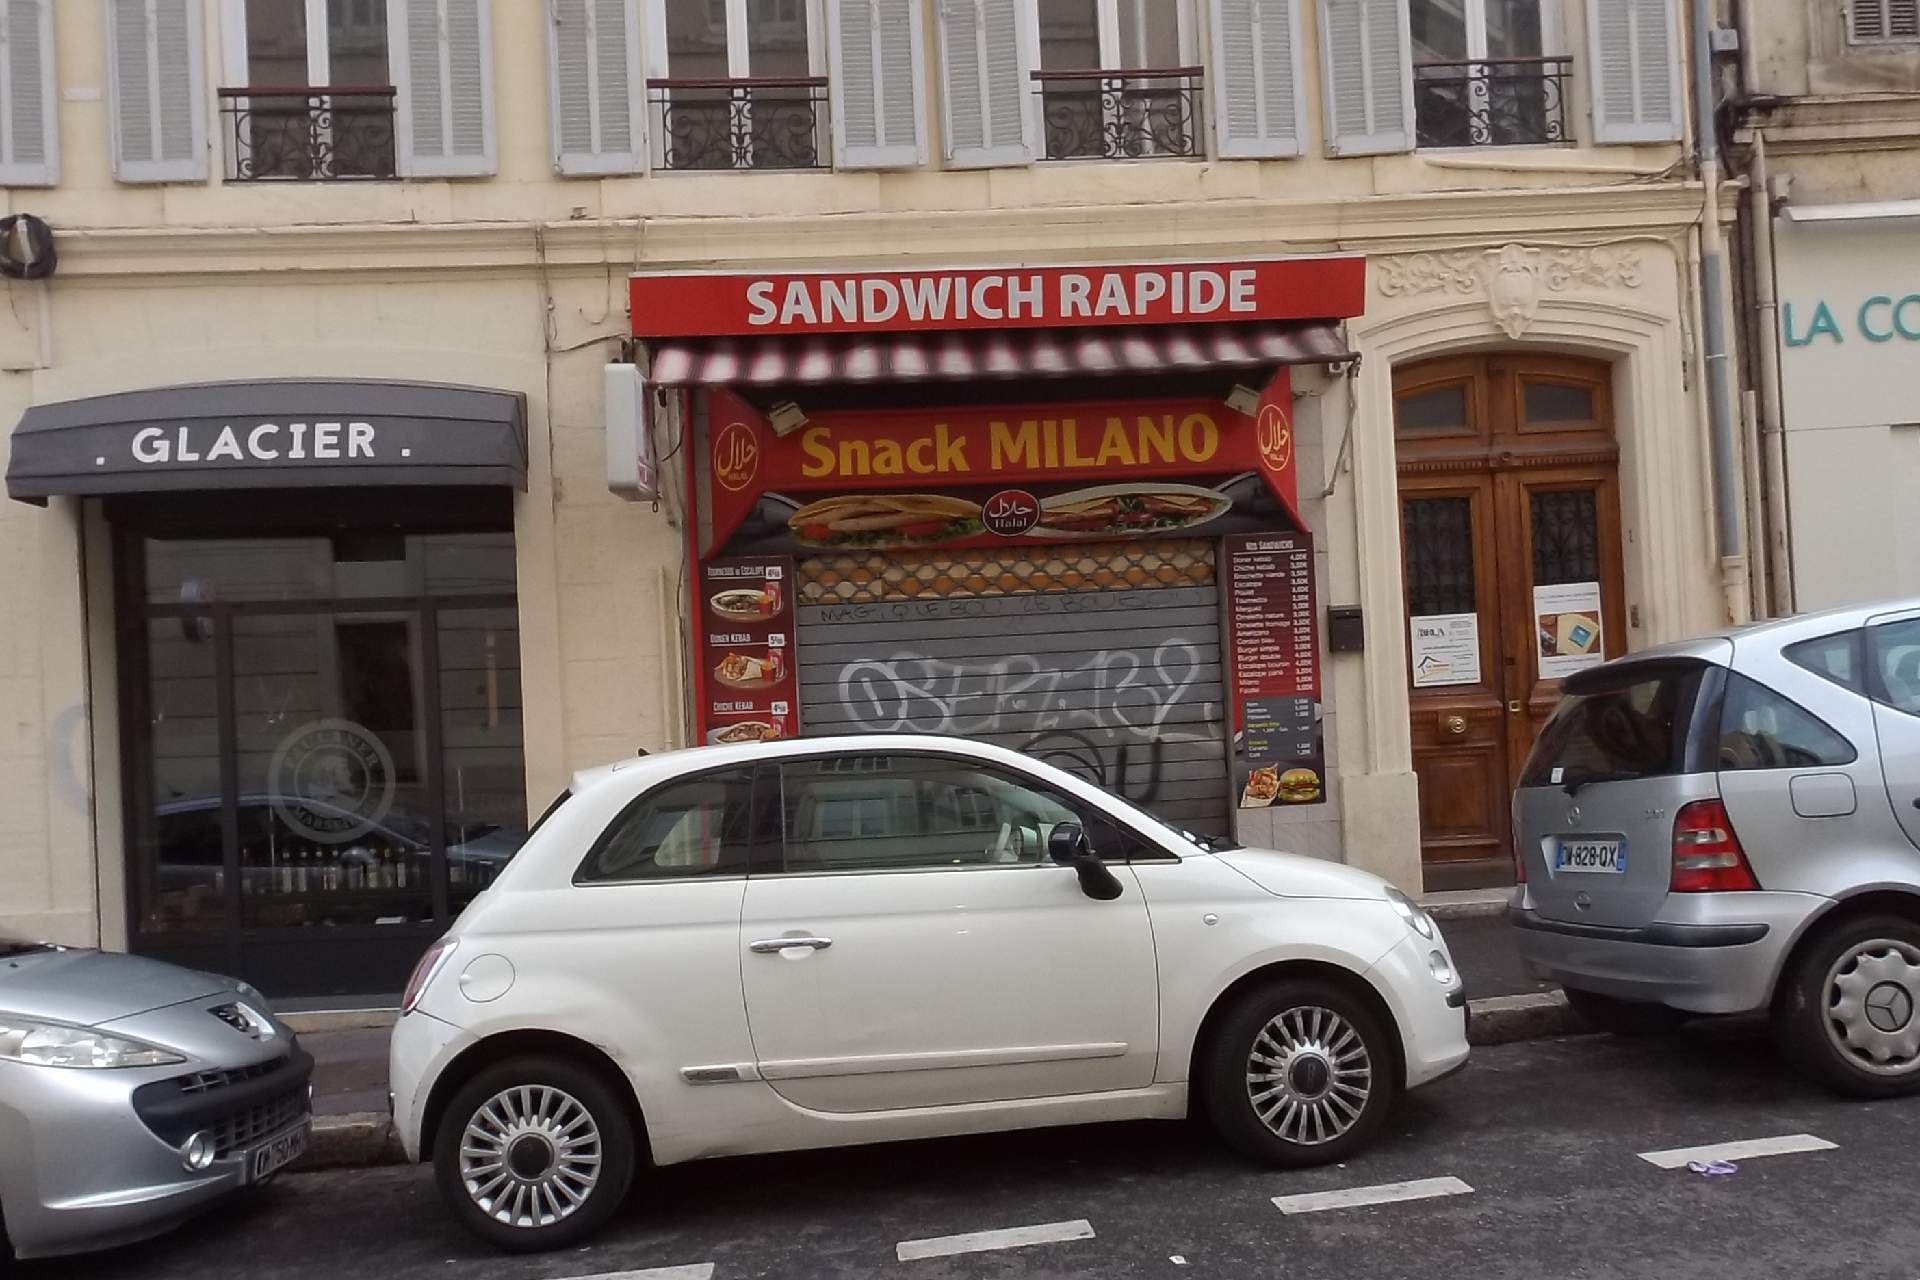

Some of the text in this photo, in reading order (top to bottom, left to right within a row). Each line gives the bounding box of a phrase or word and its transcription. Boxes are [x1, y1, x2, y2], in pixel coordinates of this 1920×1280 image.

[746, 270, 1257, 325] SANDWICH RAPIDE
[1783, 300, 1844, 347] LA
[131, 422, 376, 463] GLACIER
[801, 414, 1219, 477] Snack MILANO
[995, 517, 1027, 528] Halal
